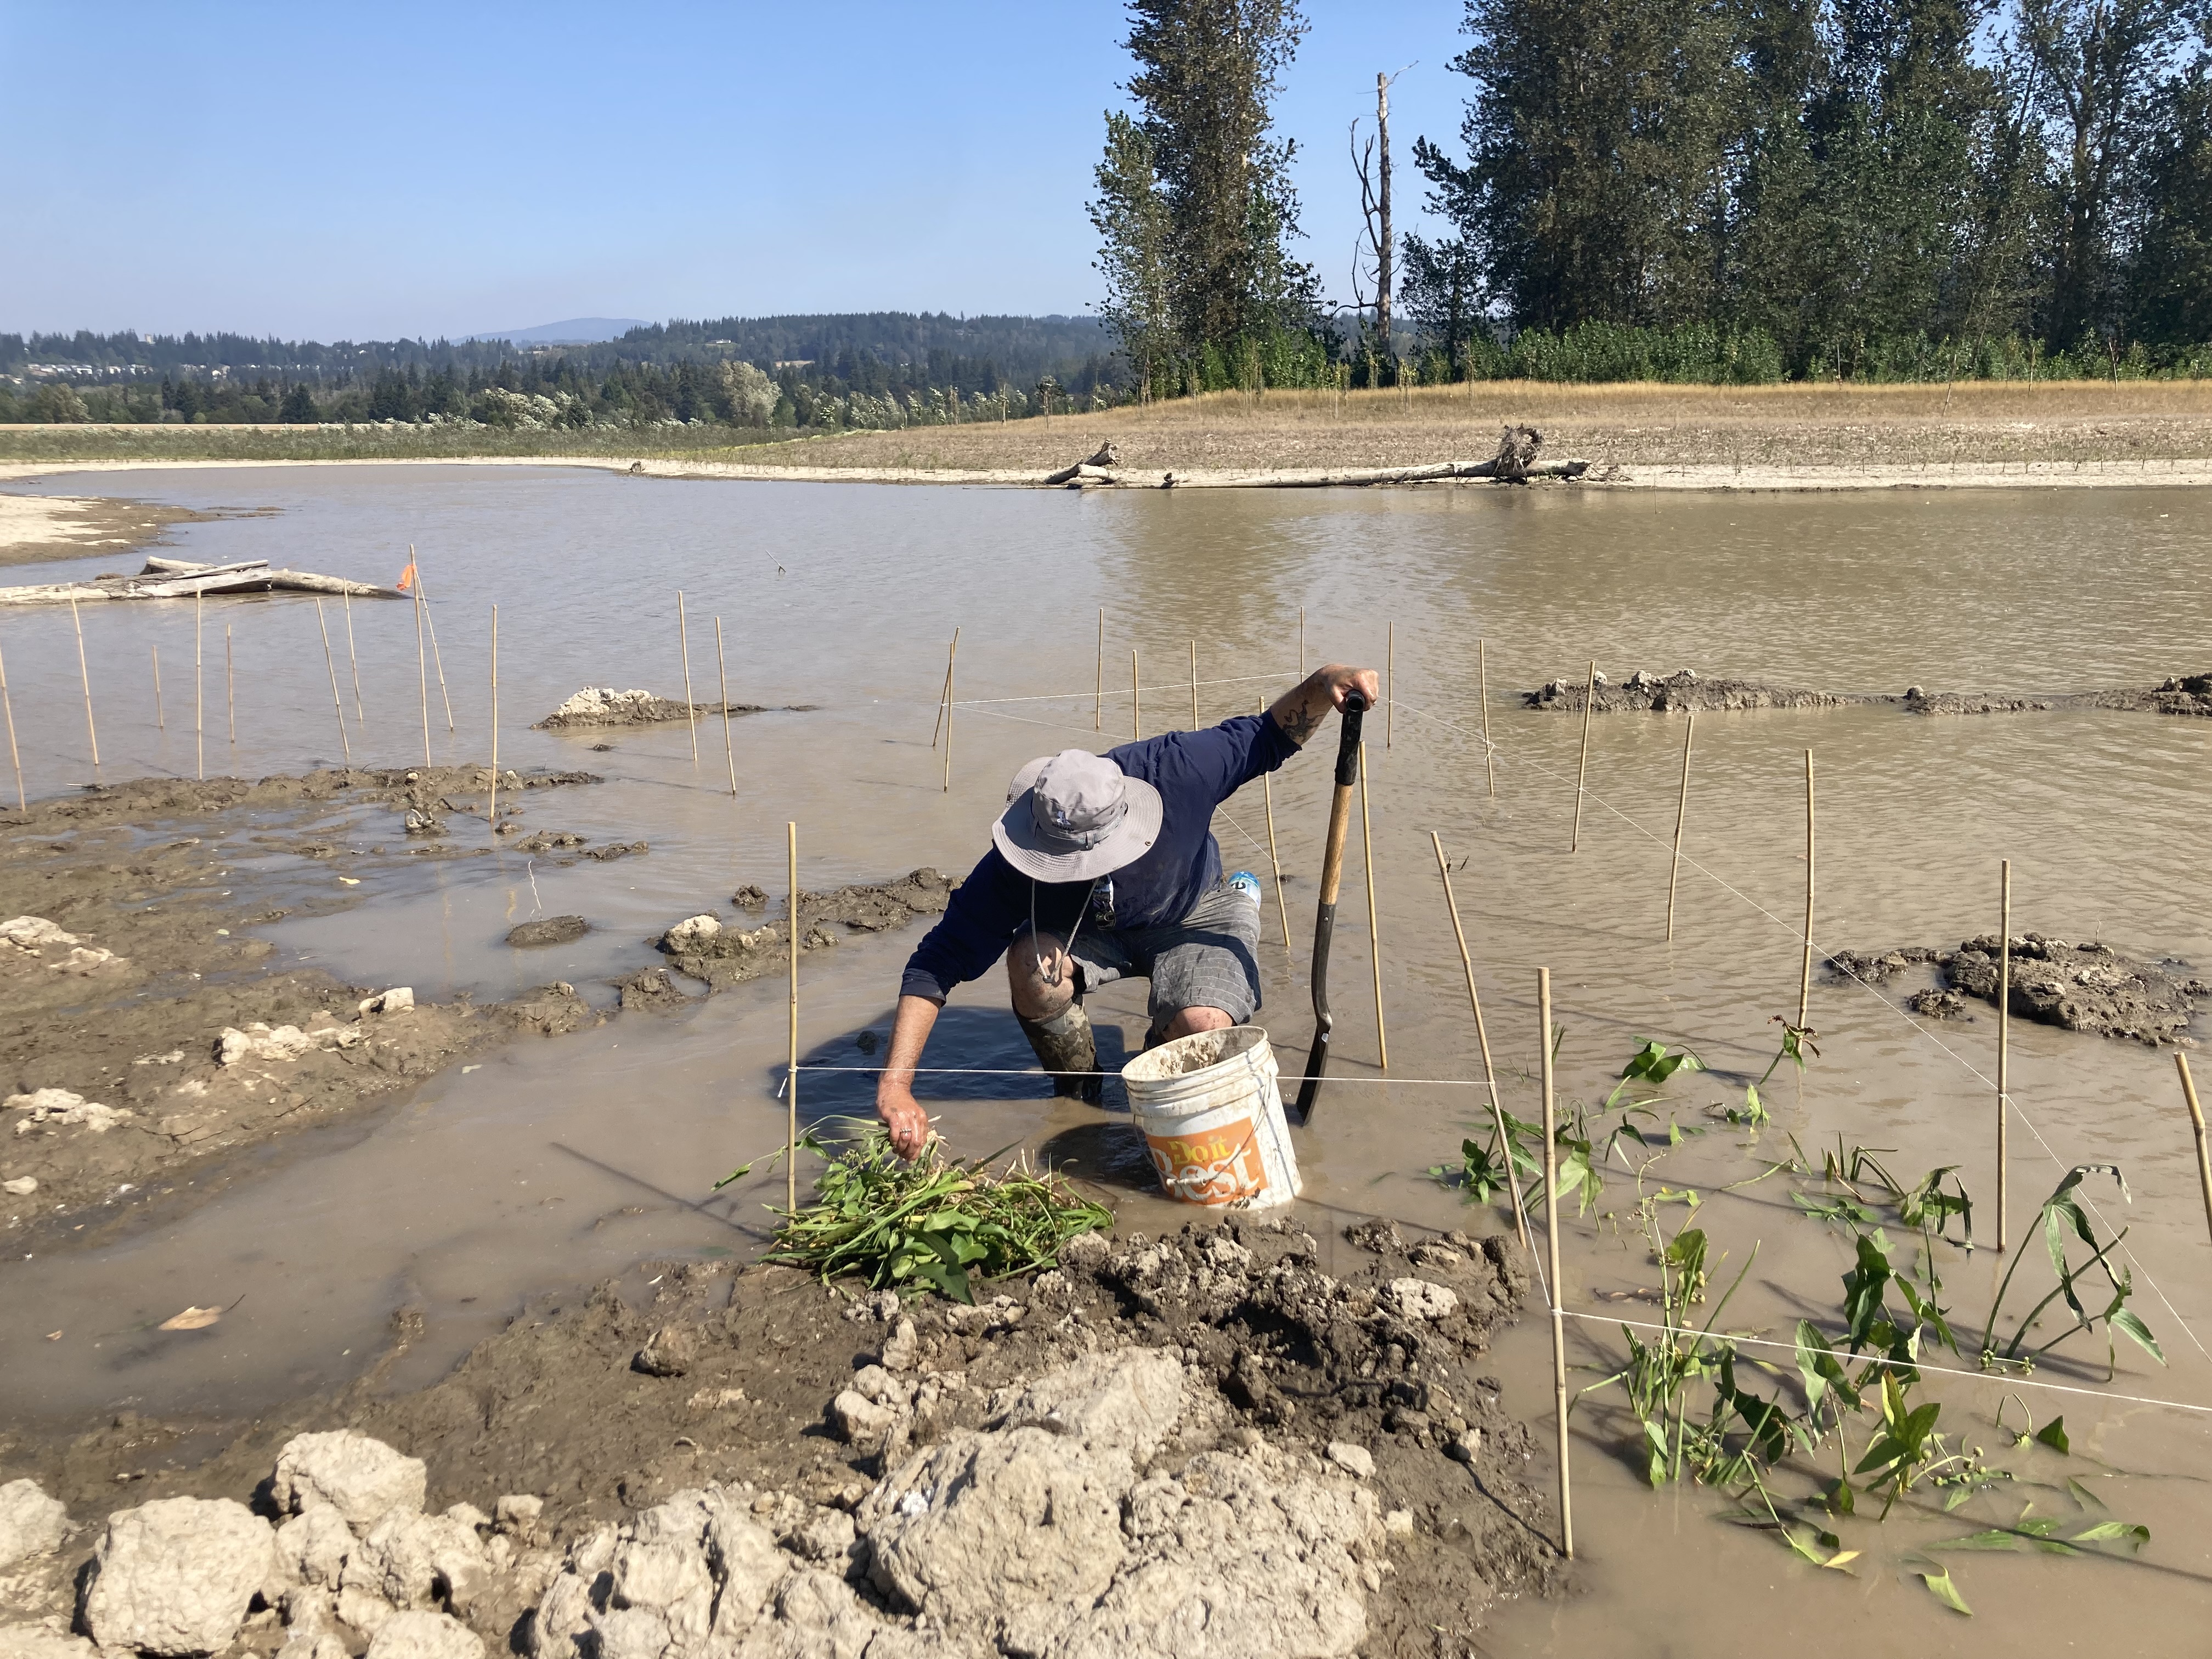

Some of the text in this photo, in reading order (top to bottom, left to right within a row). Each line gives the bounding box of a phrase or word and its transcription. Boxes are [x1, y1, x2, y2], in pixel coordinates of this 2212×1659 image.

[1150, 1143, 1260, 1201] Best
[1167, 1136, 1231, 1165] Do it
